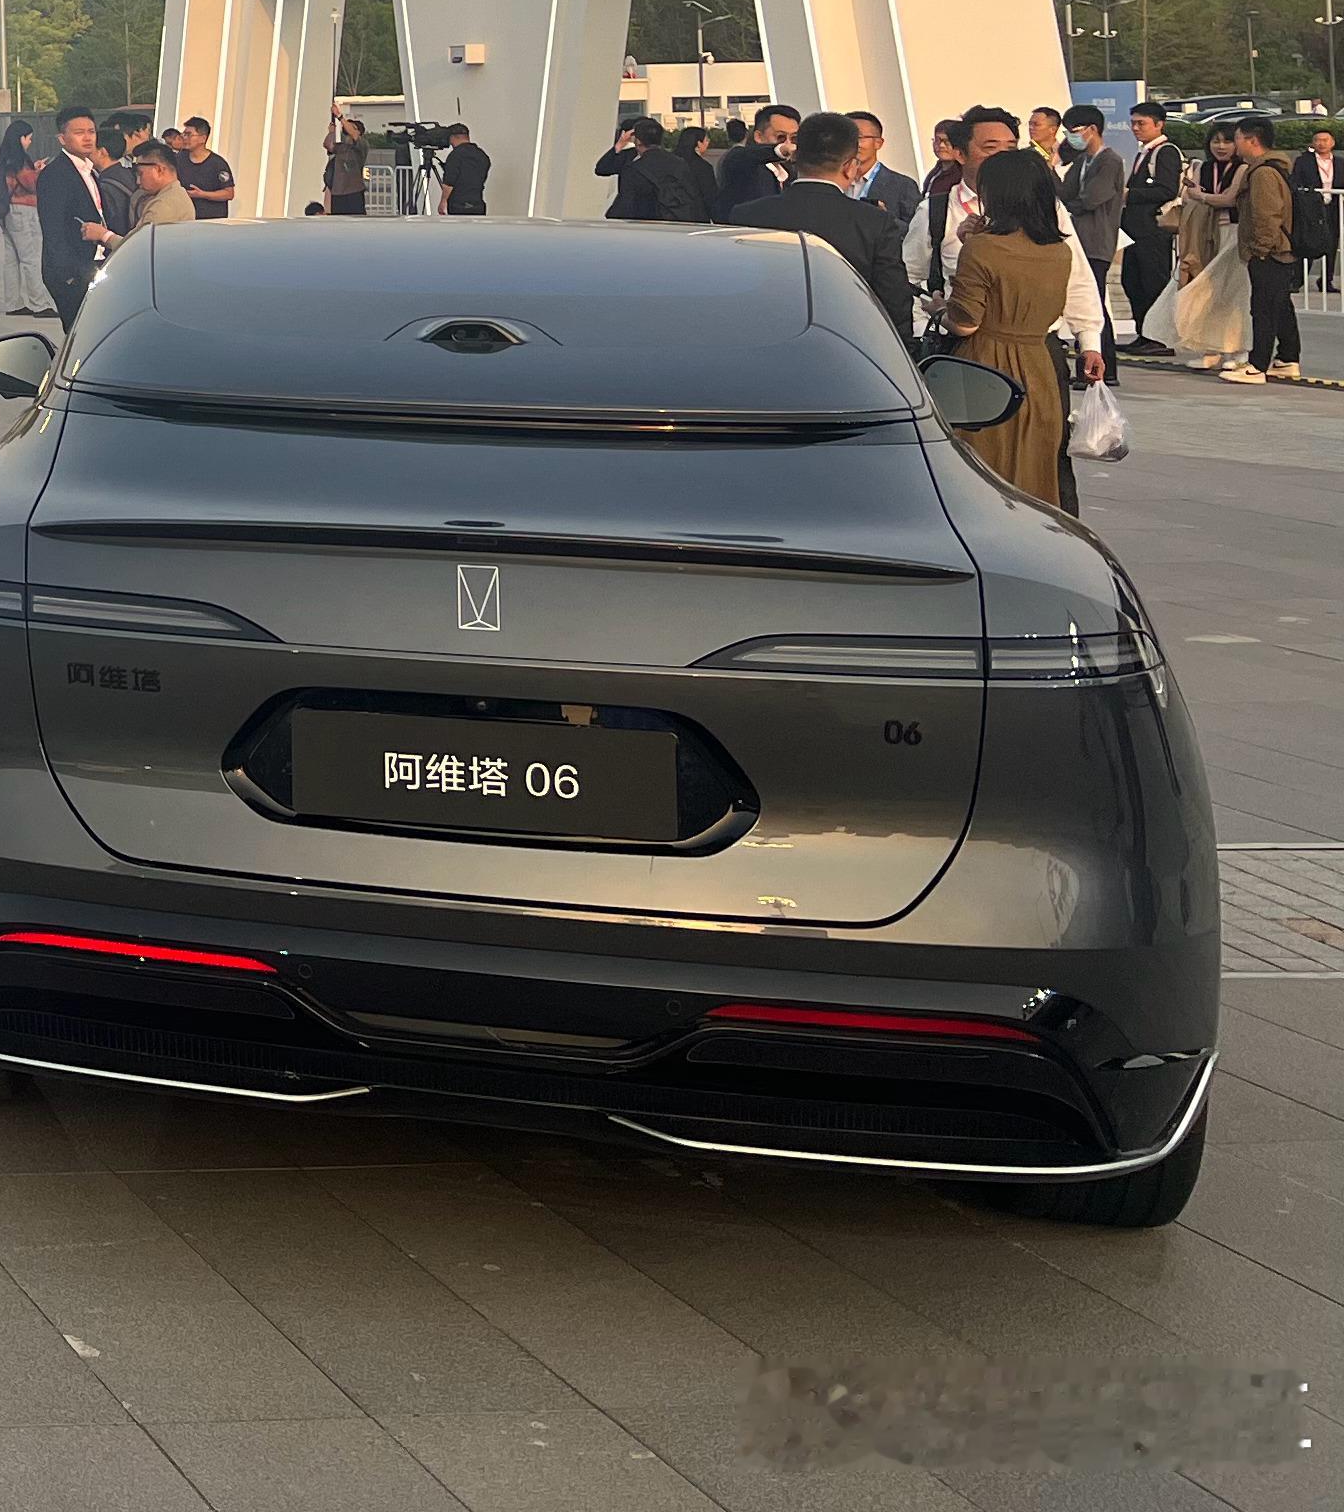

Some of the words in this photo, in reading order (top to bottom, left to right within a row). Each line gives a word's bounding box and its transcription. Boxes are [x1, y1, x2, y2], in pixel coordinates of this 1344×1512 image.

[67, 662, 161, 692] 阿维塔
[884, 720, 922, 745] 06
[384, 752, 509, 797] 阿维塔
[525, 762, 580, 799] 06
